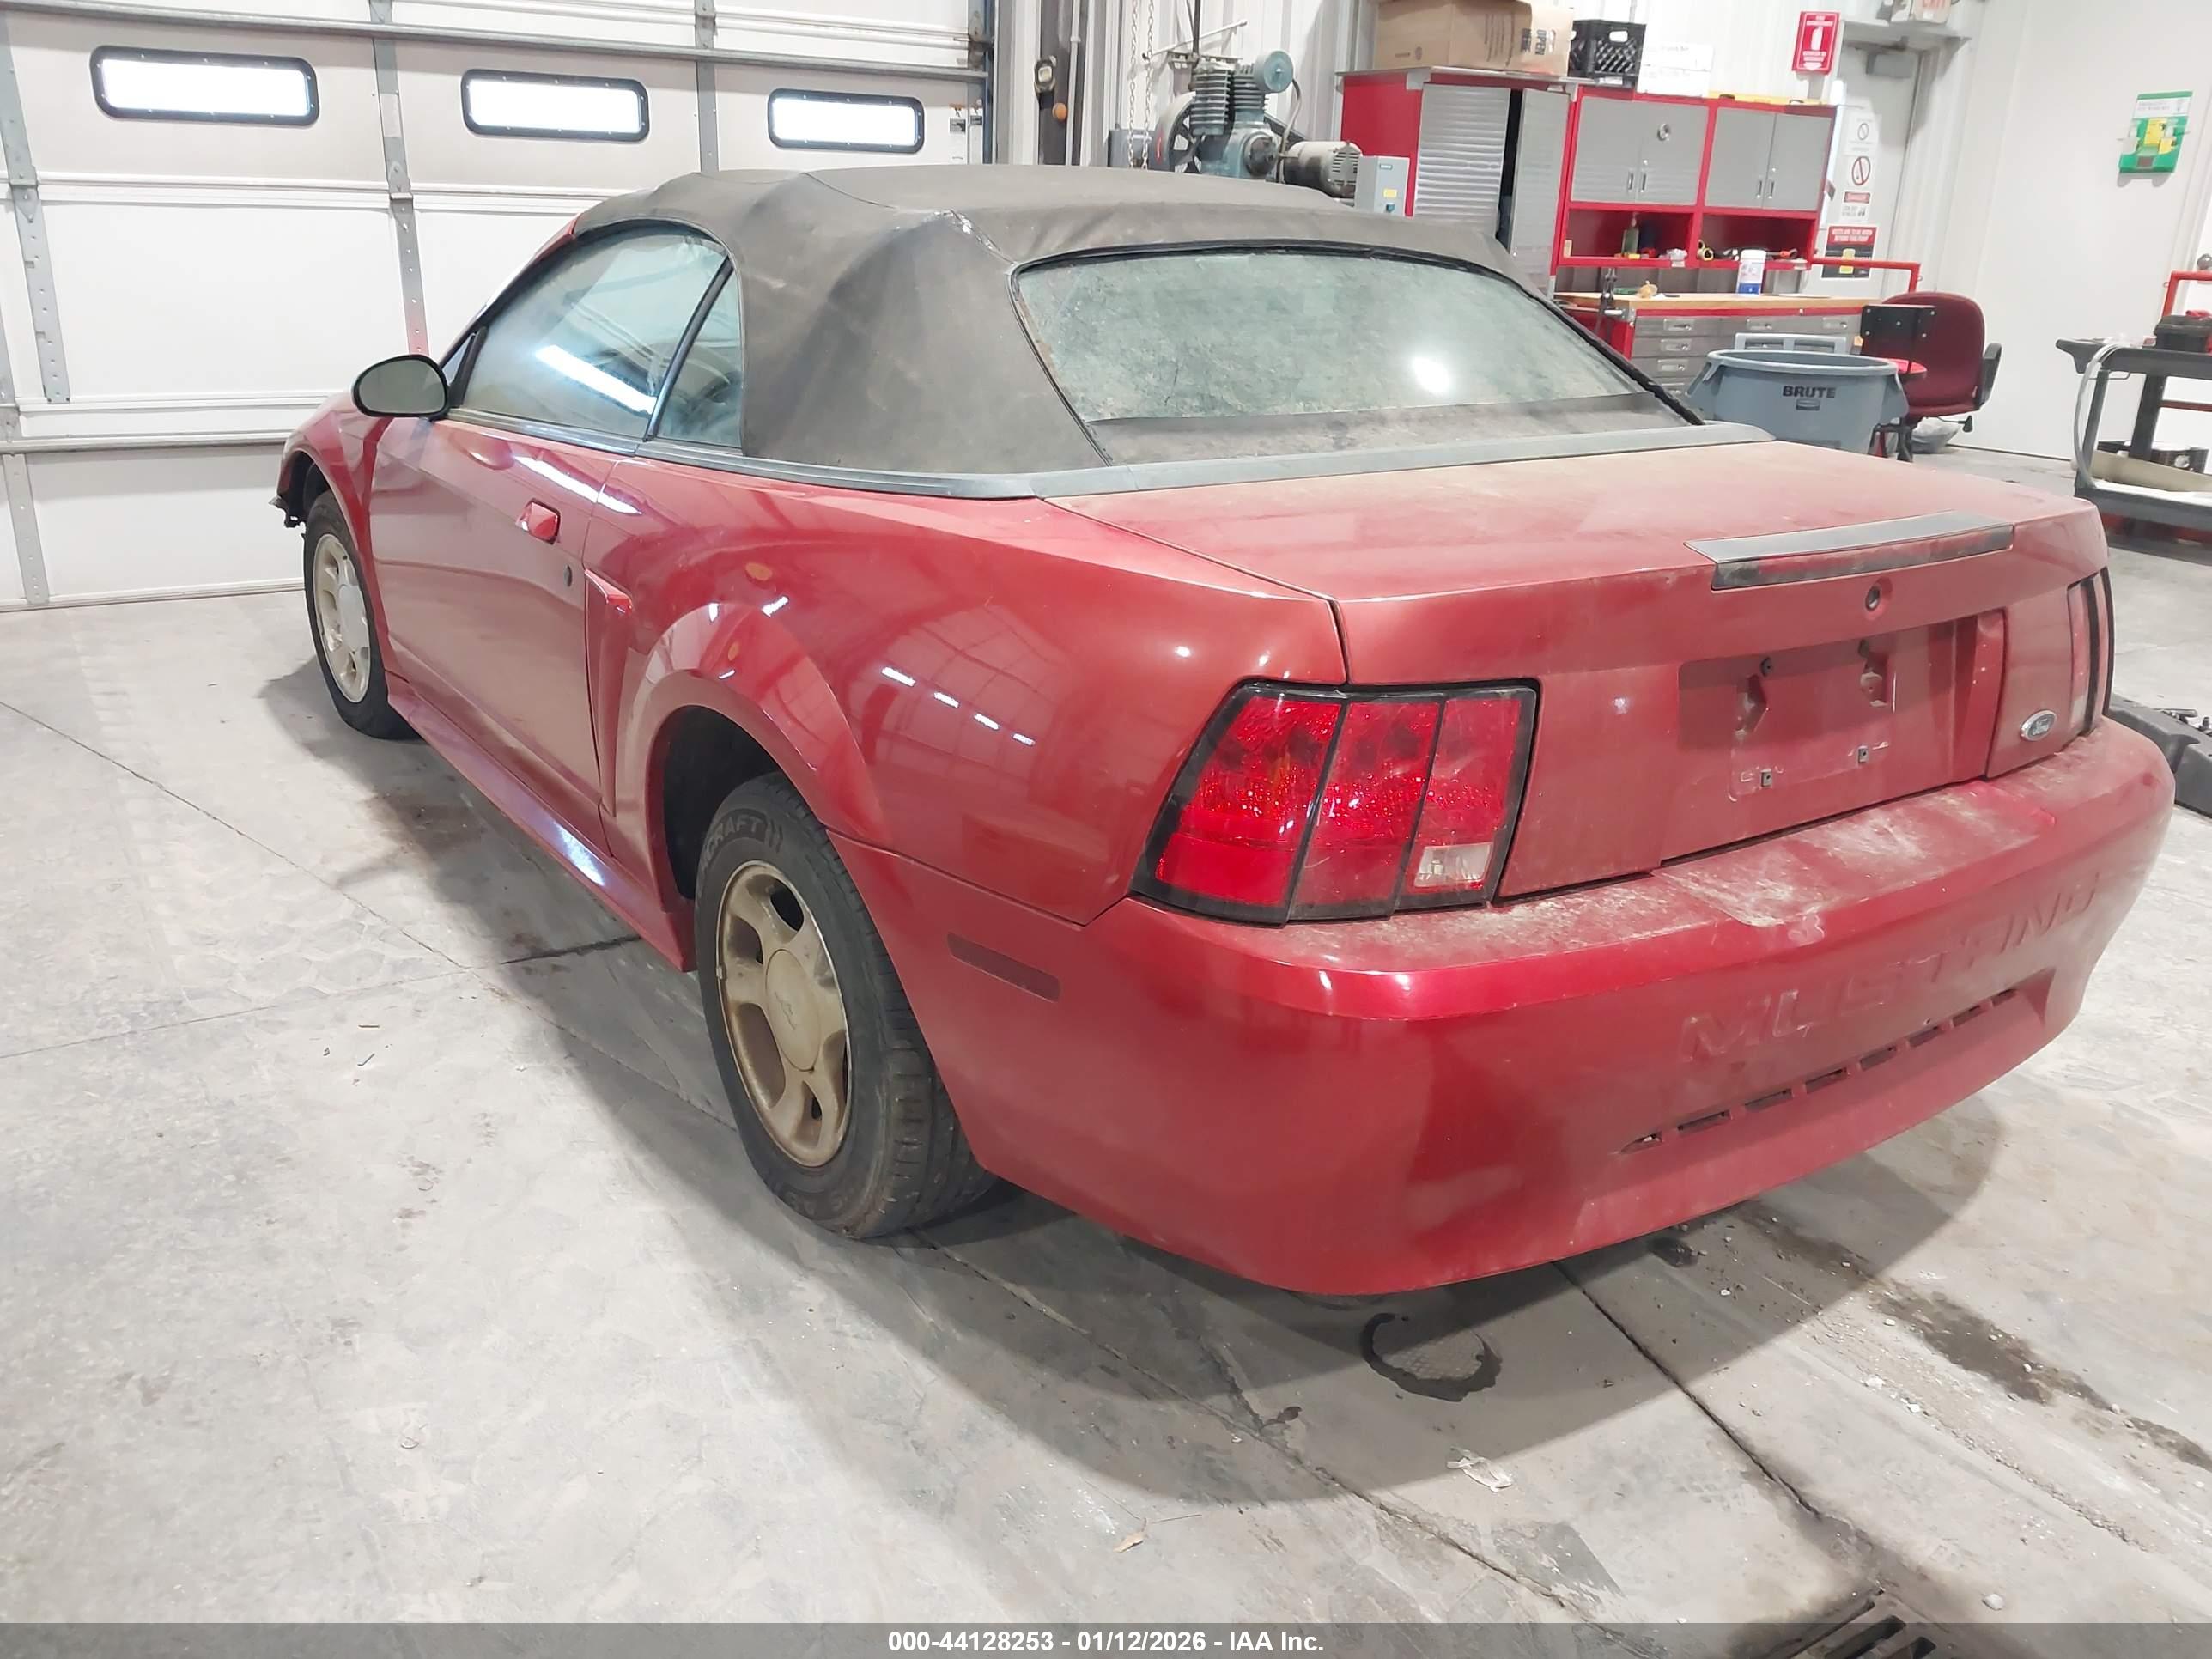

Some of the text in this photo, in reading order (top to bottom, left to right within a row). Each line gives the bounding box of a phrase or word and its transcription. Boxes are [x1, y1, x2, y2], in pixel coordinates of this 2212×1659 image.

[1534, 29, 1547, 55] OPEN
[1782, 385, 1836, 398] BRUTE
[1678, 871, 2101, 1062] MUSTANG
